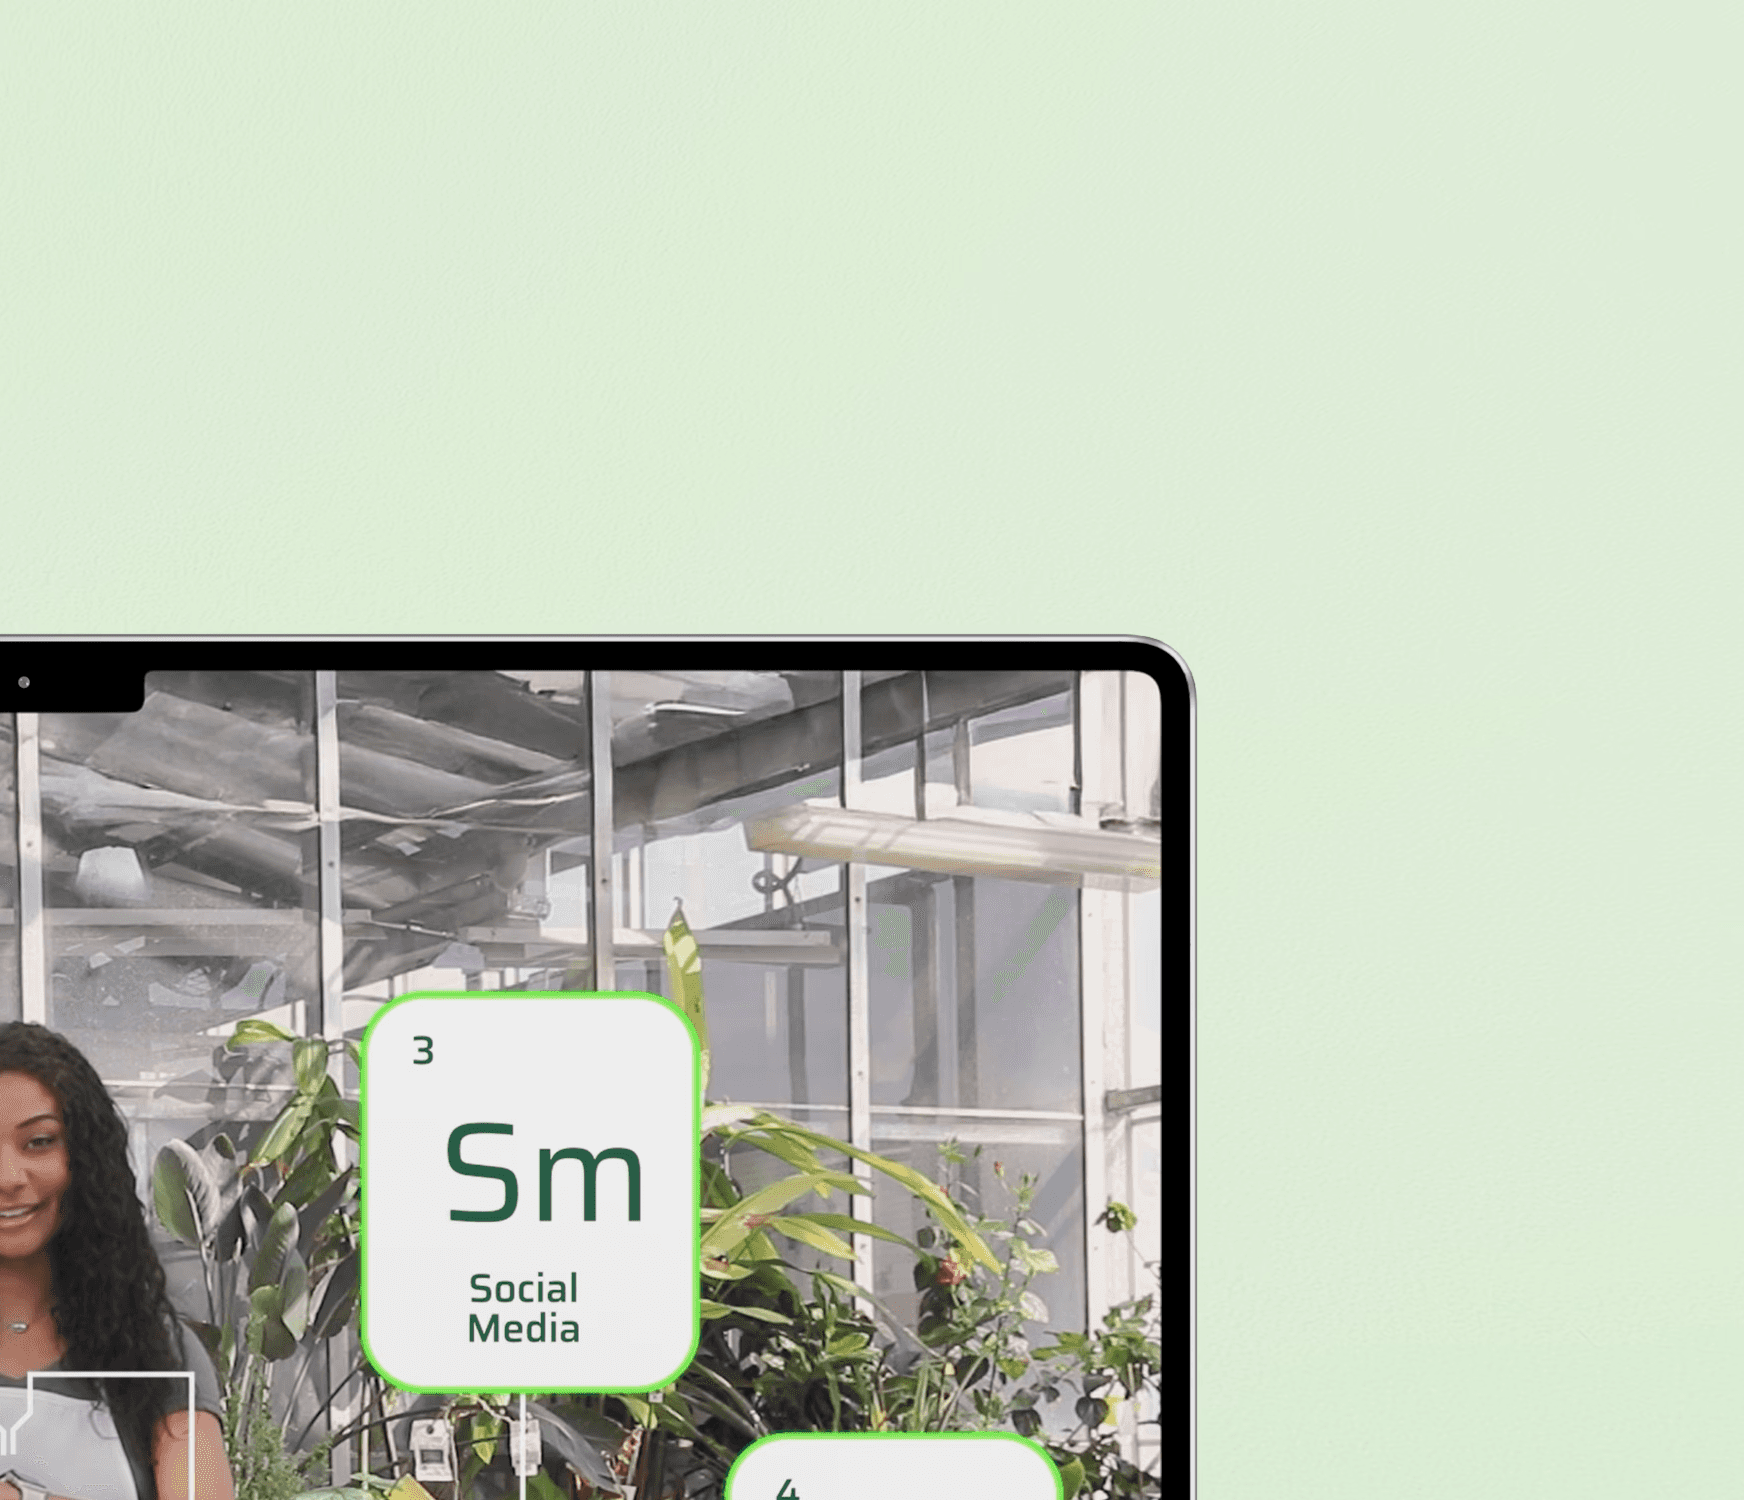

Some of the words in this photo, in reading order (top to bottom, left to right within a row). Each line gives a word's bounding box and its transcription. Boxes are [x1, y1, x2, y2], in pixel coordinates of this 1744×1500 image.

[413, 1035, 434, 1065] 3
[447, 1122, 641, 1223] Sm
[470, 1271, 577, 1303] Social
[469, 1311, 579, 1343] Media
